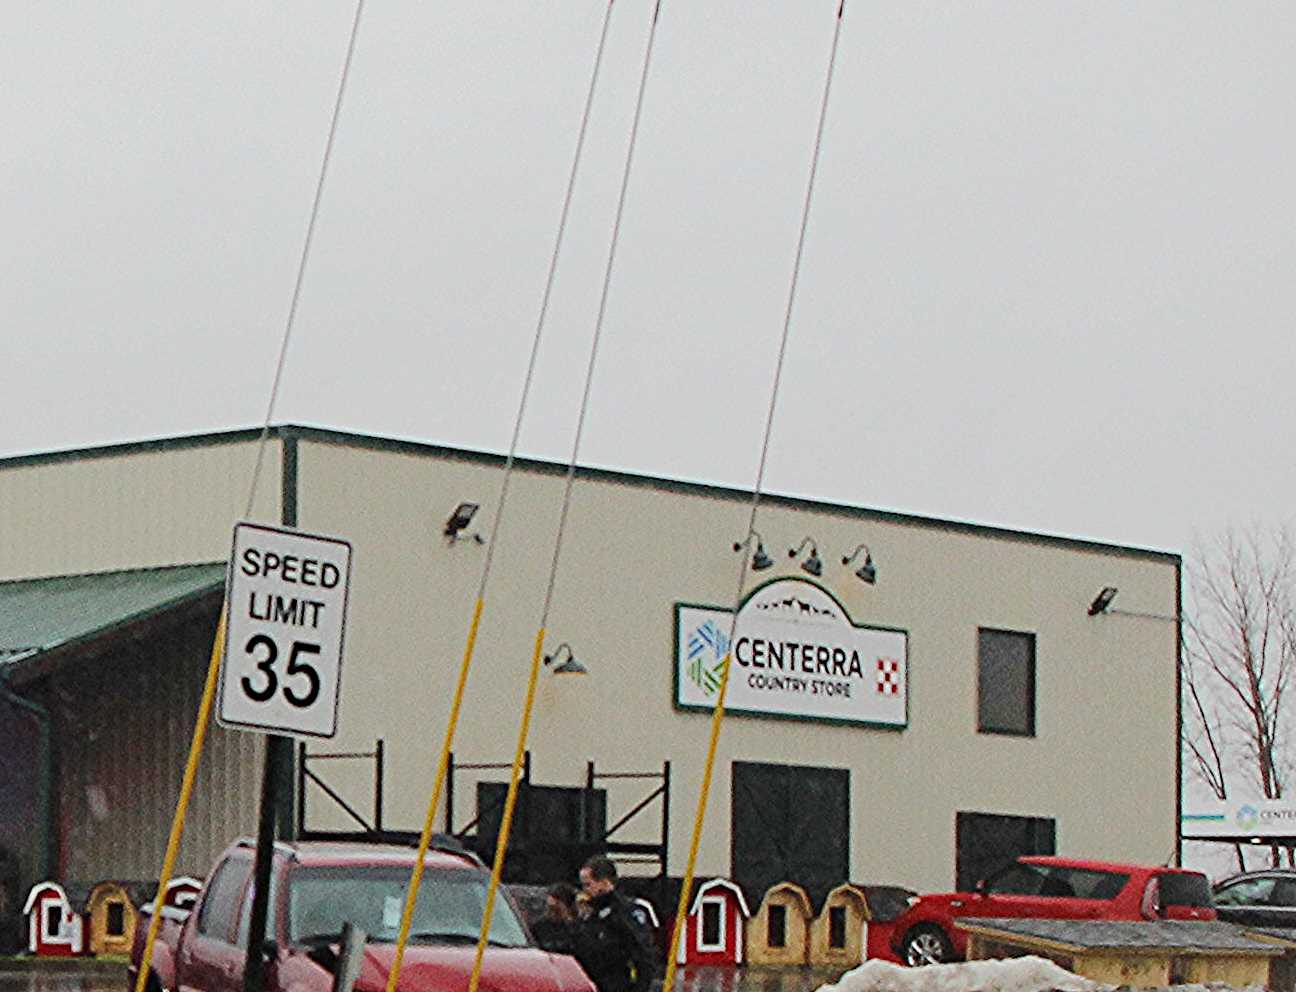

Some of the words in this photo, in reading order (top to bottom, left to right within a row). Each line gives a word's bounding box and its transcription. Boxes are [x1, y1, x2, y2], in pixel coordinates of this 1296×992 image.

[241, 548, 340, 589] SPEED
[249, 592, 325, 628] LIMIT
[241, 634, 321, 708] 35
[735, 637, 863, 679] CENTERRA
[748, 673, 807, 693] COUNTRY
[812, 679, 851, 698] STORE
